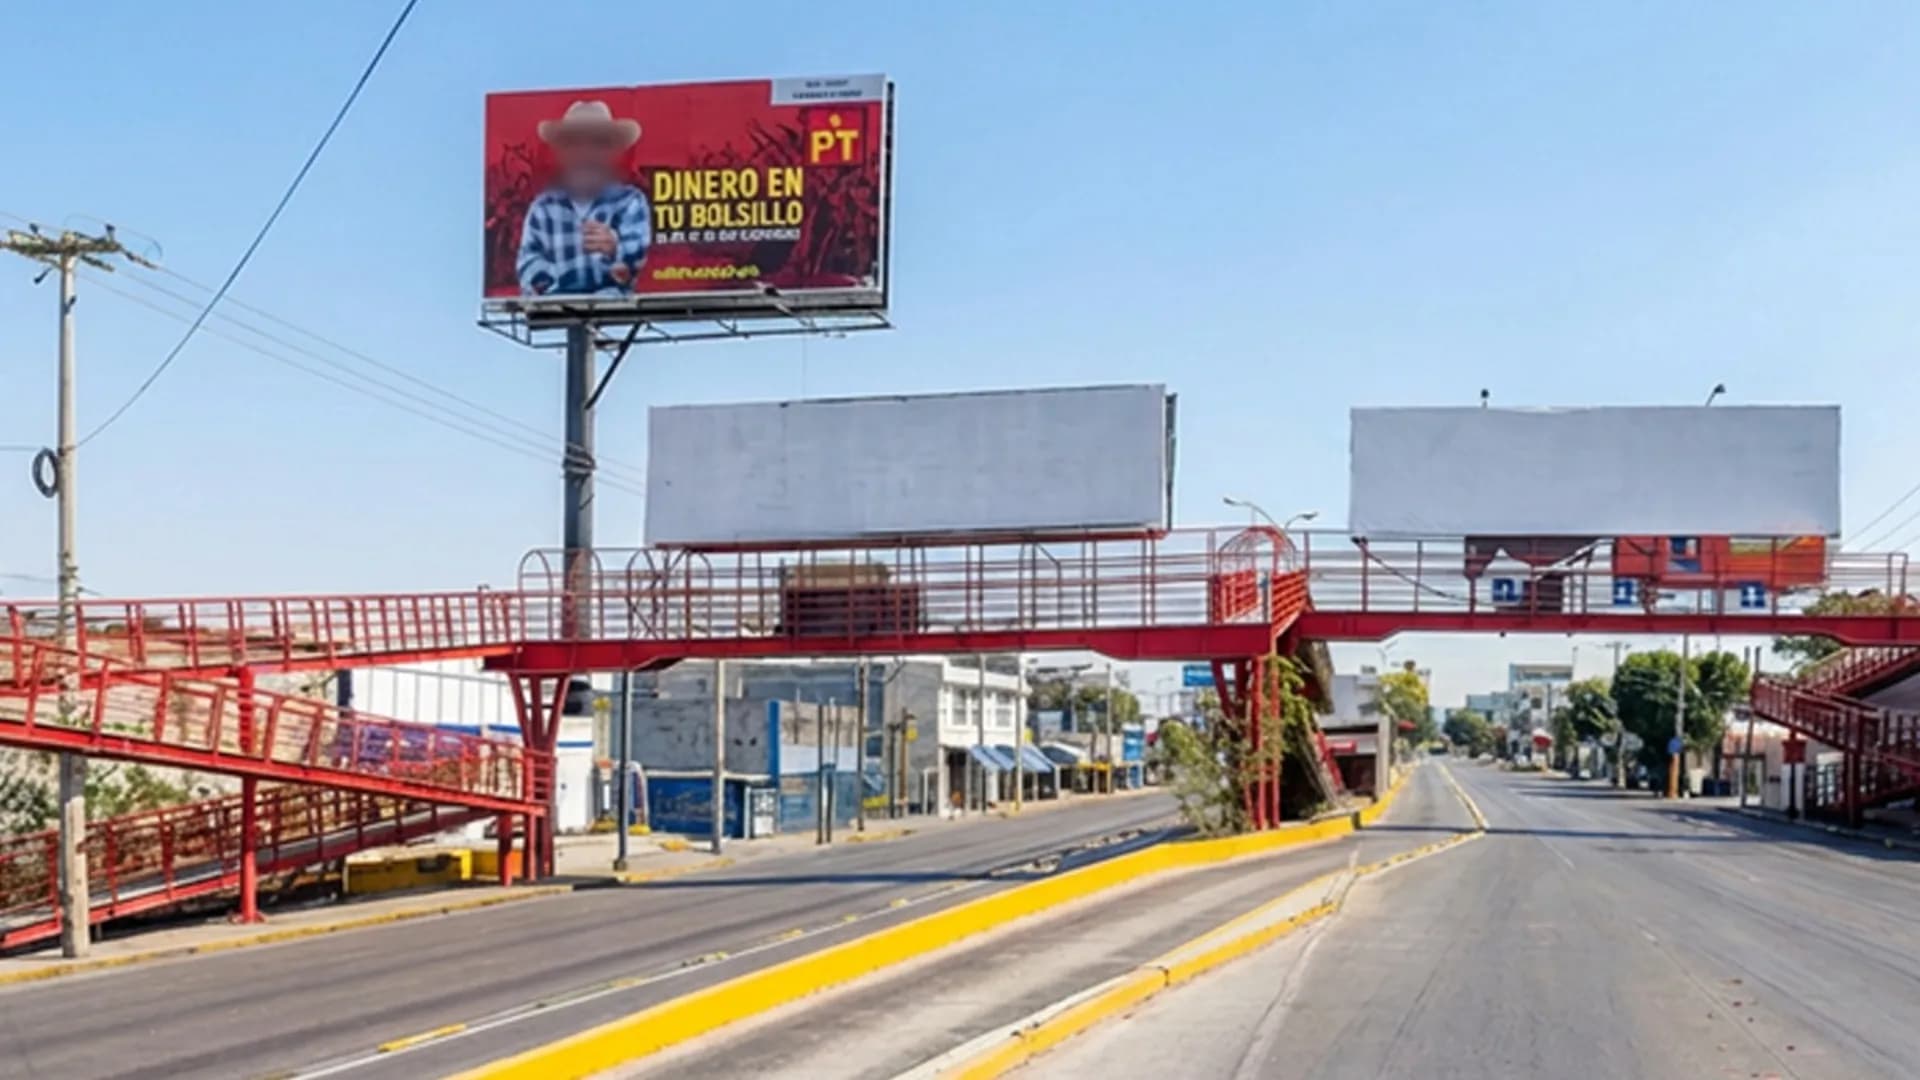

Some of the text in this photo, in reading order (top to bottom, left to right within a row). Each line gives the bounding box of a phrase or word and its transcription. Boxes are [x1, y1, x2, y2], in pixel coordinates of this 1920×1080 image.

[811, 129, 859, 163] PT
[654, 166, 803, 202] DINERO EN
[655, 200, 803, 229] TU BOLSILLO
